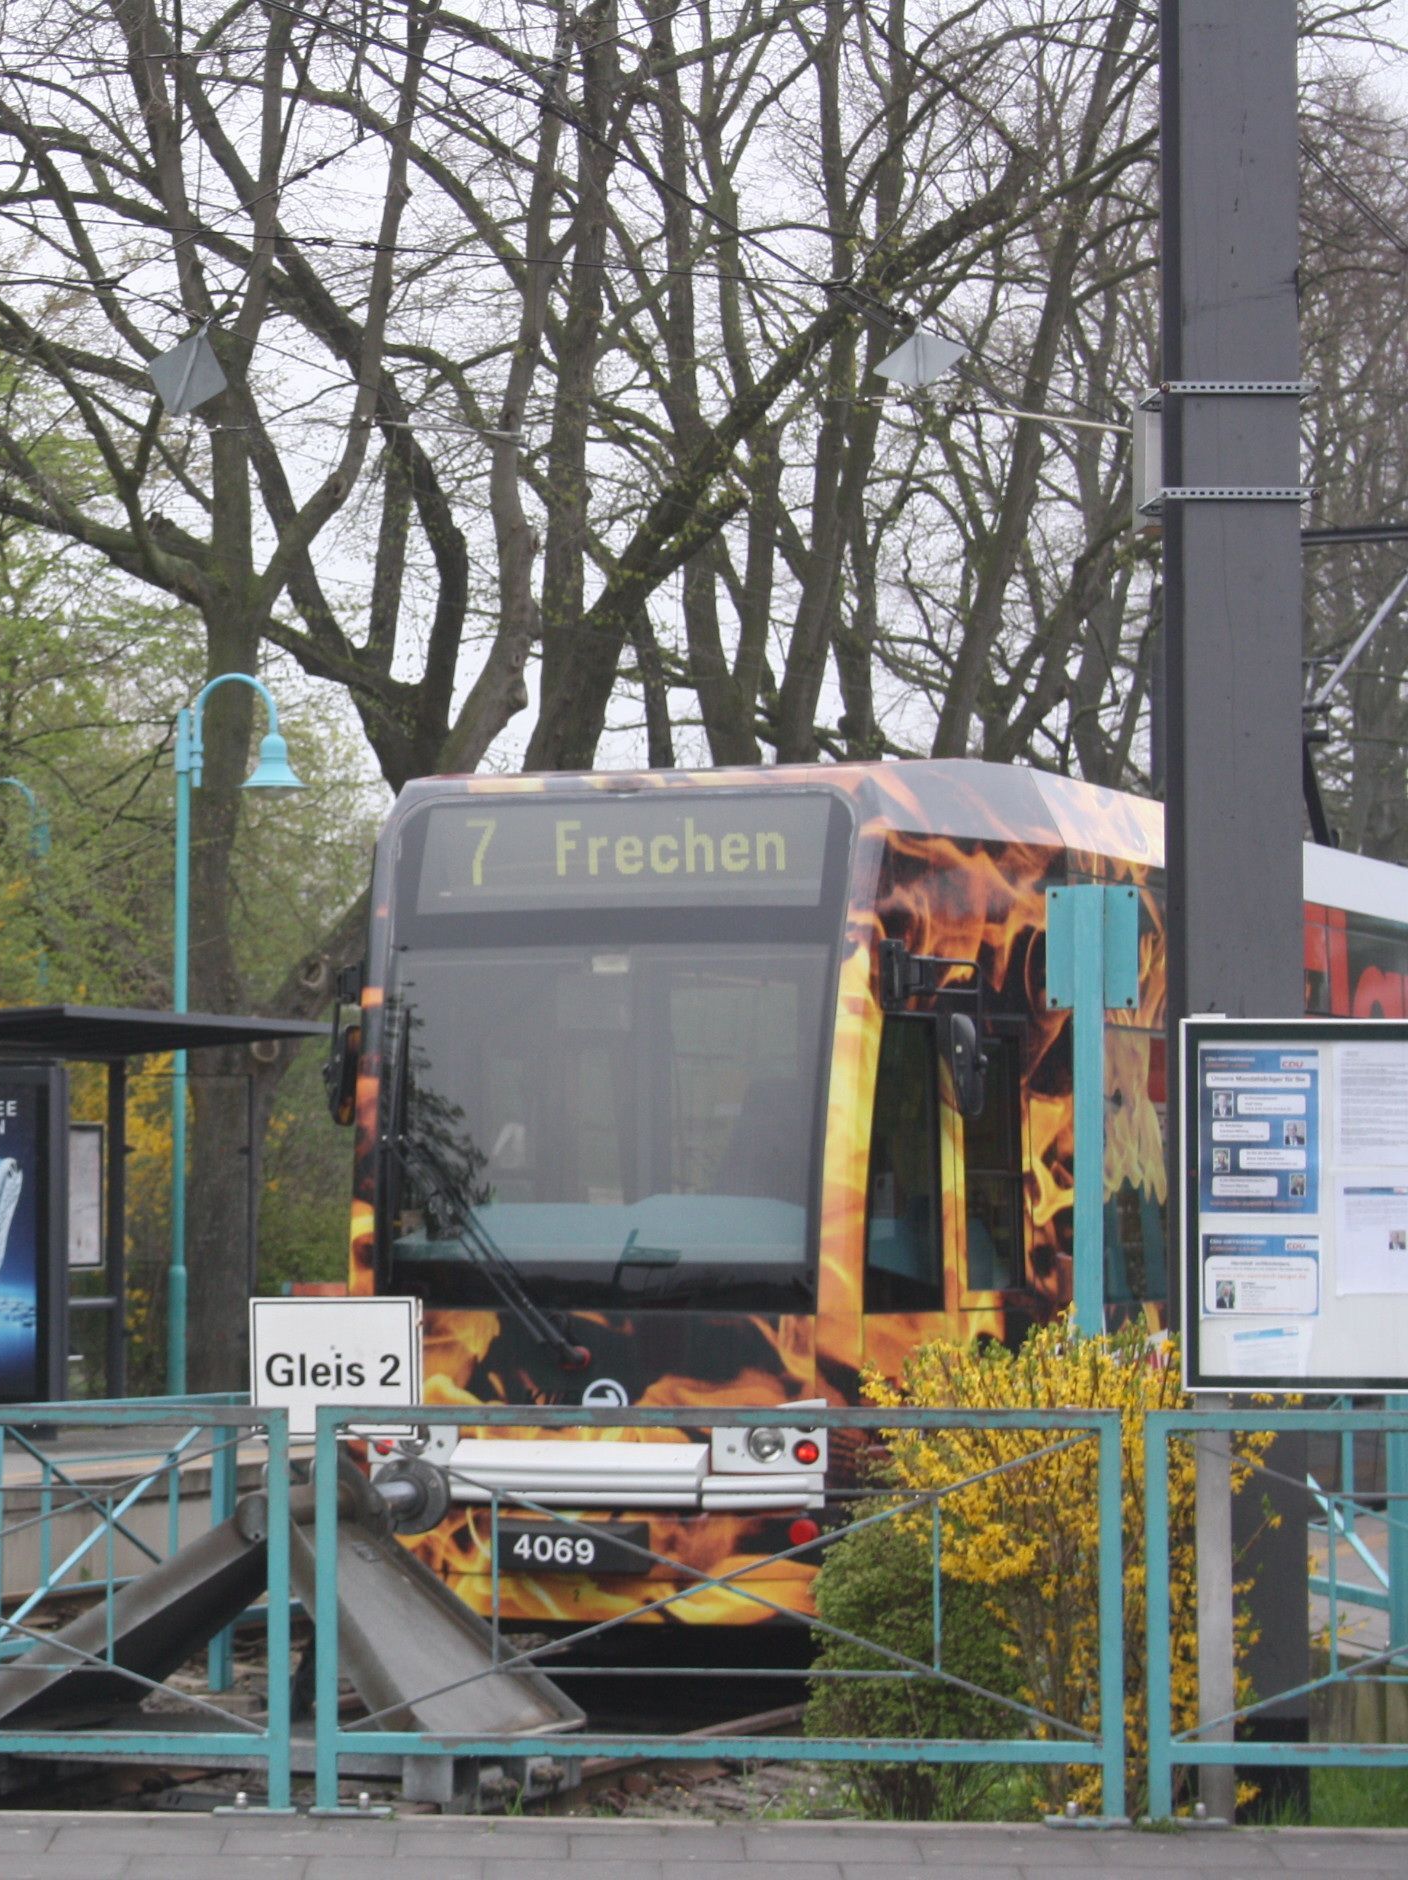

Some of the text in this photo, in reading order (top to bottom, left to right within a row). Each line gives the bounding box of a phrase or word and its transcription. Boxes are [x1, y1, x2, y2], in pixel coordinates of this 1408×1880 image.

[466, 817, 786, 886] 7 Frechen
[1282, 1061, 1304, 1069] CDU
[265, 1352, 401, 1387] Gleis 2
[513, 1534, 595, 1565] 4069
